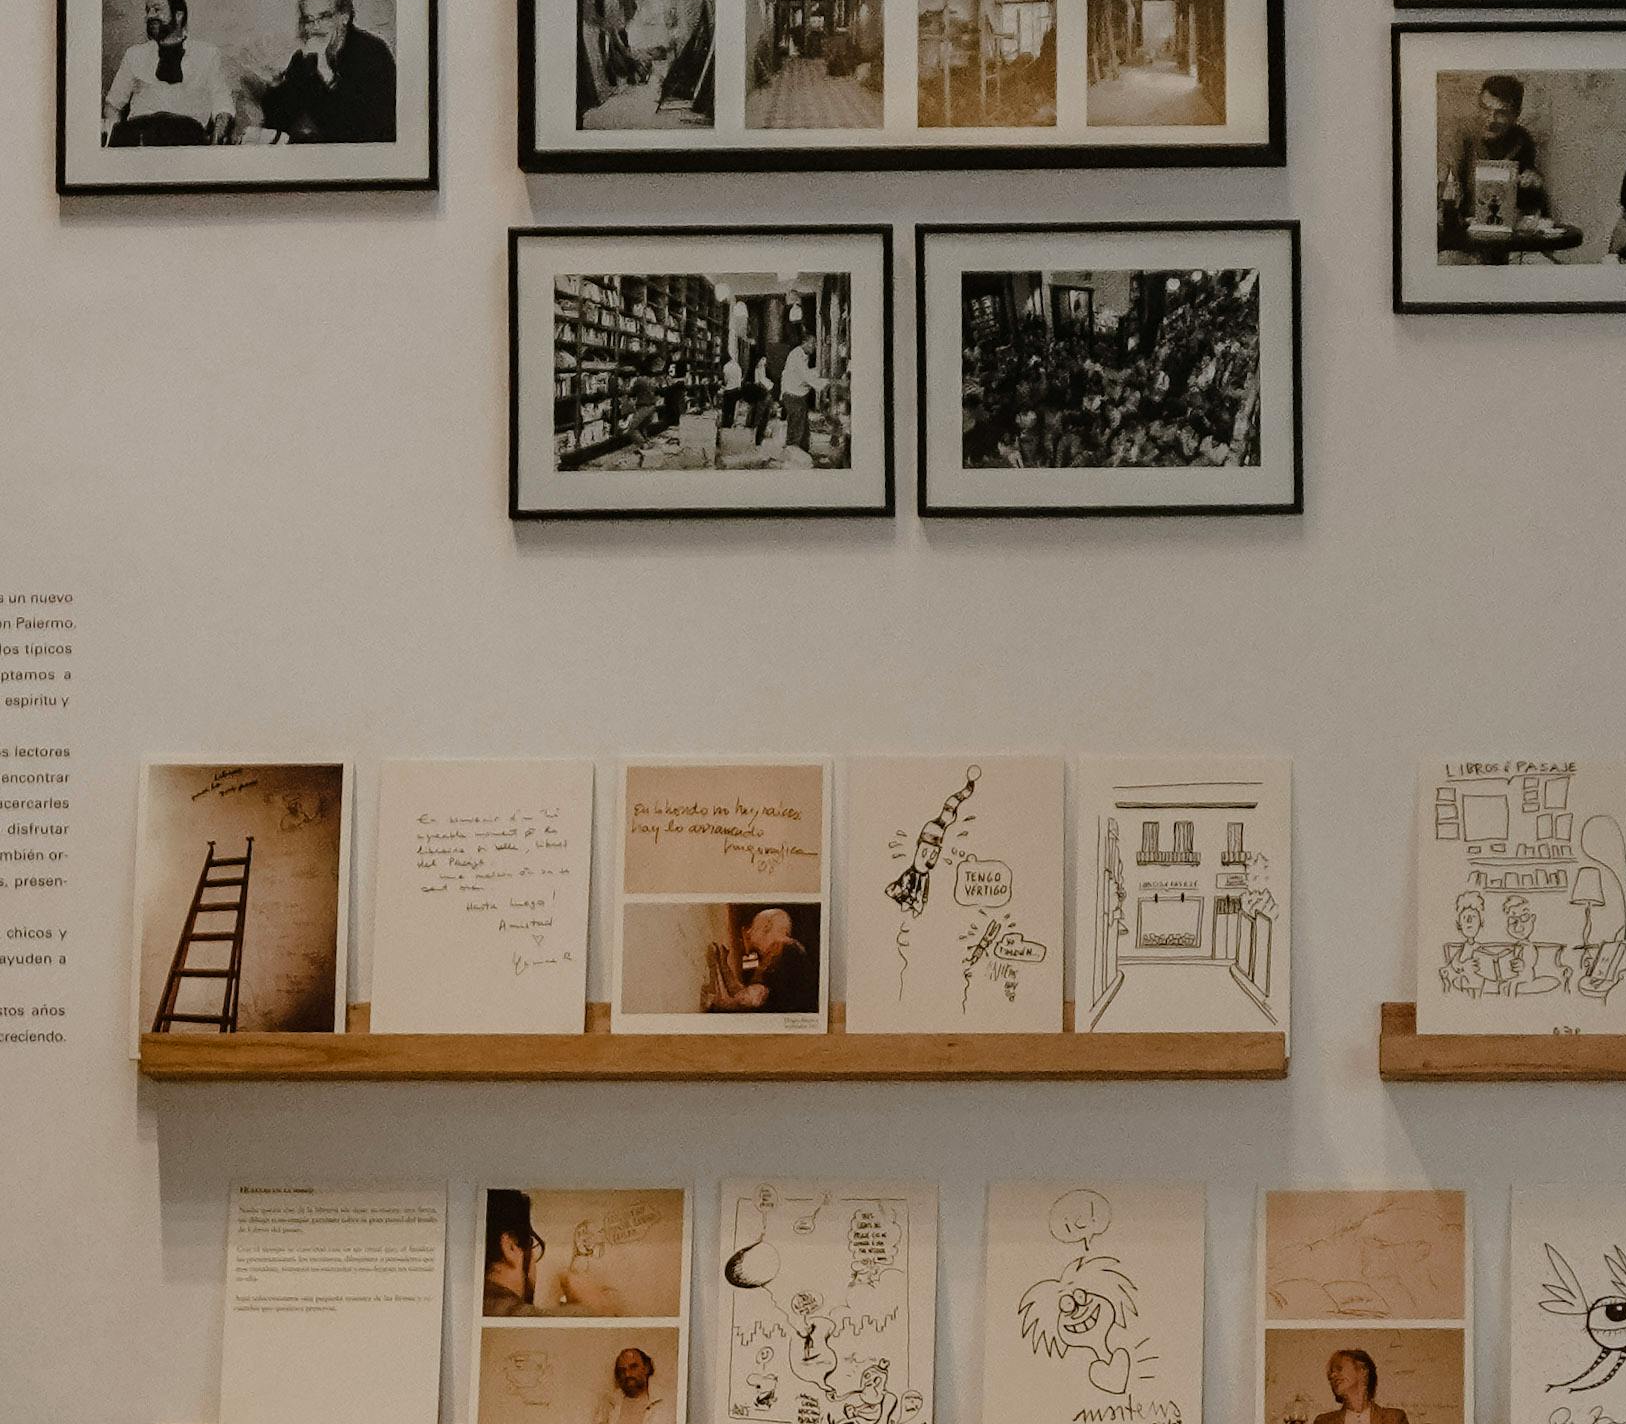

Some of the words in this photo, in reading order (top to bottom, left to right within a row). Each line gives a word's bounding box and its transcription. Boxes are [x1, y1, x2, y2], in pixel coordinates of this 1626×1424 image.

[9, 594, 26, 604] un
[31, 594, 73, 604] nuevo
[64, 671, 71, 680] a
[62, 697, 69, 707] y
[15, 746, 70, 757] lectores
[1445, 761, 1499, 777] LIBROS
[1515, 760, 1578, 773] PASAJE
[2, 774, 69, 783] encontrar
[7, 822, 69, 835] disfrutar
[965, 871, 1001, 882] TENGO
[14, 877, 67, 889] presen-
[964, 884, 1008, 897] VERTIGO
[6, 927, 52, 939] chicos
[59, 929, 67, 940] y
[59, 955, 66, 964] a
